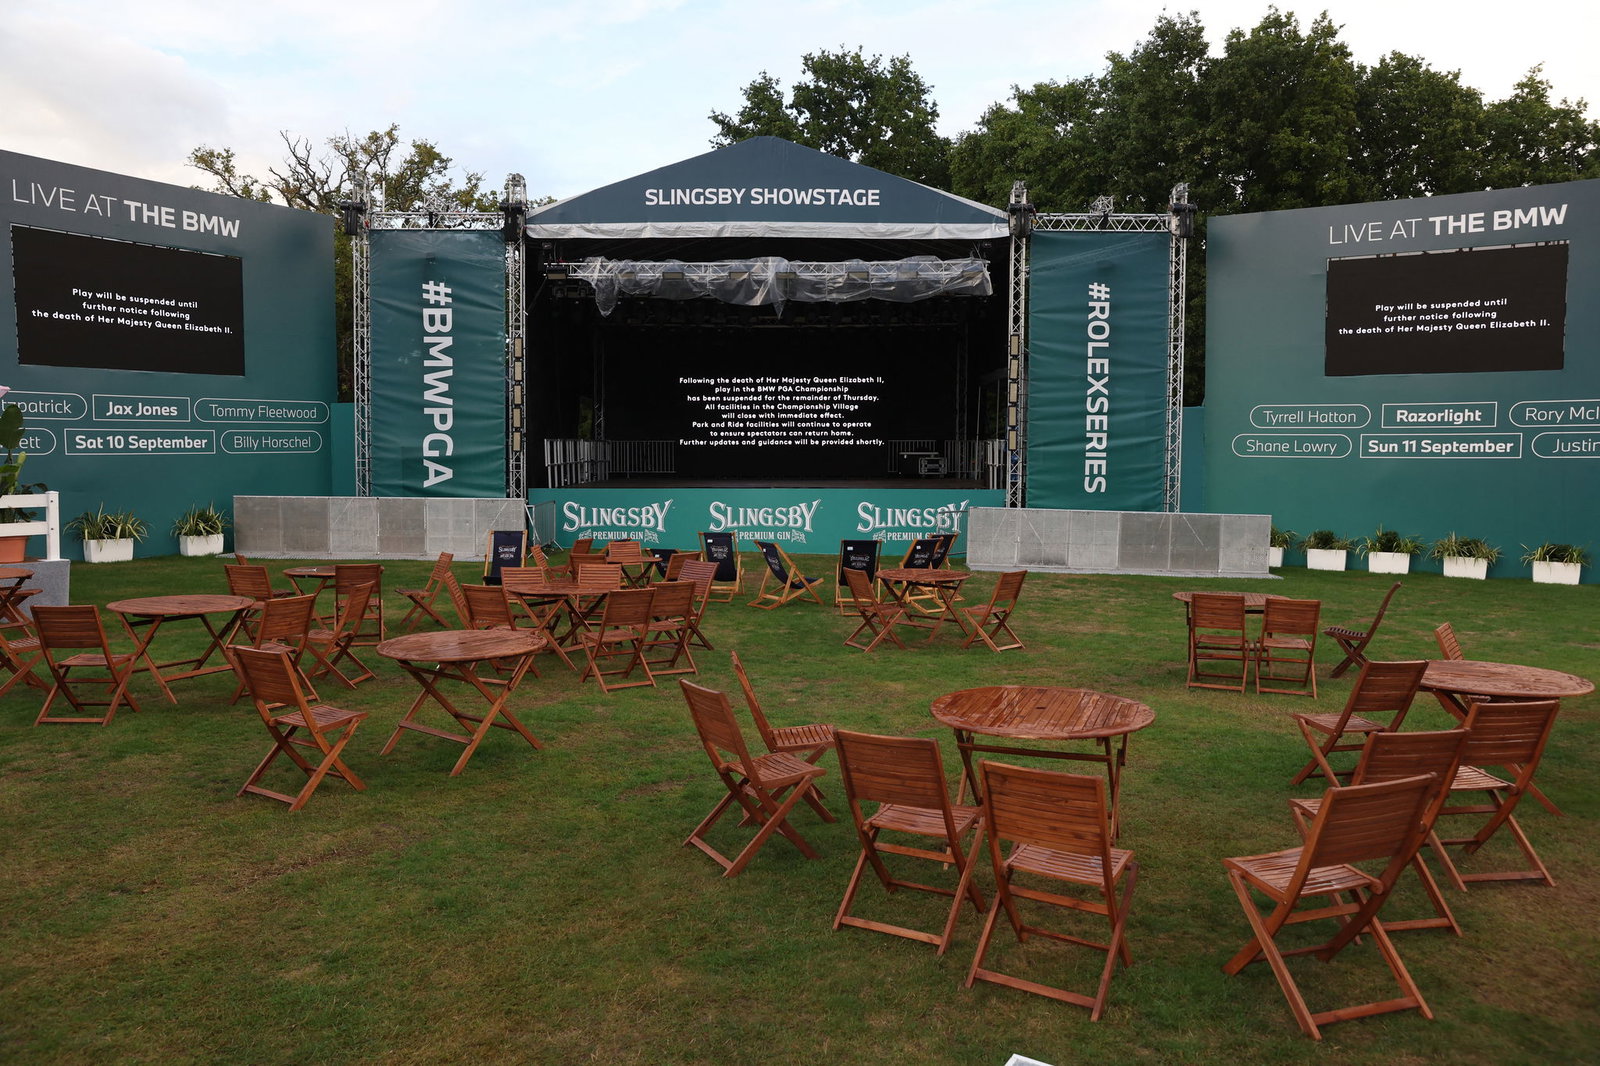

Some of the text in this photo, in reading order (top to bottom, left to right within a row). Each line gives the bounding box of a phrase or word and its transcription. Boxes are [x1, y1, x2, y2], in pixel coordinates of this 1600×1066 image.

[645, 187, 880, 206] SLINGSBY SHOWSTAGE
[13, 179, 240, 238] LIVE AT THE BMW
[1328, 204, 1568, 245] LIVE AT THE BMW
[72, 288, 198, 309] Play will be suspended until
[1375, 297, 1508, 313] Play will be suspended until
[81, 301, 190, 321] further notice following
[1383, 310, 1497, 323] further notice following
[31, 309, 50, 318] the
[52, 310, 82, 321] death
[84, 314, 95, 322] of
[97, 315, 115, 324] Her
[117, 316, 153, 329] Majesty
[154, 320, 183, 330] Queen
[184, 322, 223, 333] Elizabeth
[1338, 327, 1354, 335] the
[1355, 326, 1382, 335] death
[1384, 325, 1395, 334] of
[1397, 325, 1414, 333] Her
[1416, 323, 1453, 334] Majesty
[1455, 322, 1487, 331] Queen
[1489, 319, 1537, 329] Elizabeth
[421, 280, 453, 488] #BMWPGA
[679, 376, 715, 386] Following
[716, 376, 730, 384] the
[731, 376, 754, 384] death
[755, 376, 764, 384] of
[766, 376, 780, 384] Her
[781, 376, 812, 385] Majesty
[812, 376, 838, 384] Queen
[839, 376, 875, 384] Elizabeth
[1084, 282, 1111, 493] #ROLEXSERIES
[714, 385, 849, 394] play in the BMW PGA Championship
[687, 394, 701, 402] has
[702, 394, 721, 402] been
[722, 394, 763, 403] suspended
[764, 394, 776, 402] for
[792, 393, 831, 402] remainder
[842, 394, 880, 403] Thursday.
[106, 401, 178, 416] Jax Jones
[209, 404, 318, 420] Tommy Fleetwood
[717, 403, 751, 411] facilities
[776, 403, 831, 412] Championship
[832, 403, 859, 412] Village
[777, 411, 818, 419] immediate
[819, 411, 845, 419] effect.
[1525, 407, 1565, 424] Rory
[710, 420, 726, 428] and
[727, 420, 744, 428] Ride
[745, 420, 780, 428] facilities
[781, 420, 795, 428] will
[796, 420, 831, 428] continue
[842, 421, 872, 429] operate
[1263, 410, 1357, 425] Tyrrell Hatton
[1396, 408, 1482, 425] Razorlight
[747, 430, 787, 438] spectators
[830, 429, 854, 437] home.
[75, 435, 207, 451] Sat 10 September
[233, 435, 311, 451] Billy Horschel
[679, 438, 708, 446] Further
[709, 438, 740, 447] updates
[741, 438, 756, 446] and
[757, 438, 793, 447] guidance
[810, 438, 820, 446] be
[821, 438, 854, 447] provided
[855, 438, 885, 447] shortly.
[1245, 439, 1337, 455] Shane Lowry
[1367, 439, 1514, 456] Sun 11 September
[563, 499, 673, 532] SLINGSBY
[709, 499, 821, 533] SLINGSBY
[857, 499, 969, 533] SLINGSBY
[592, 531, 644, 540] PREMIUM GIN
[739, 531, 791, 540] PREMIUM GIN
[887, 531, 922, 541] PREMIUM
